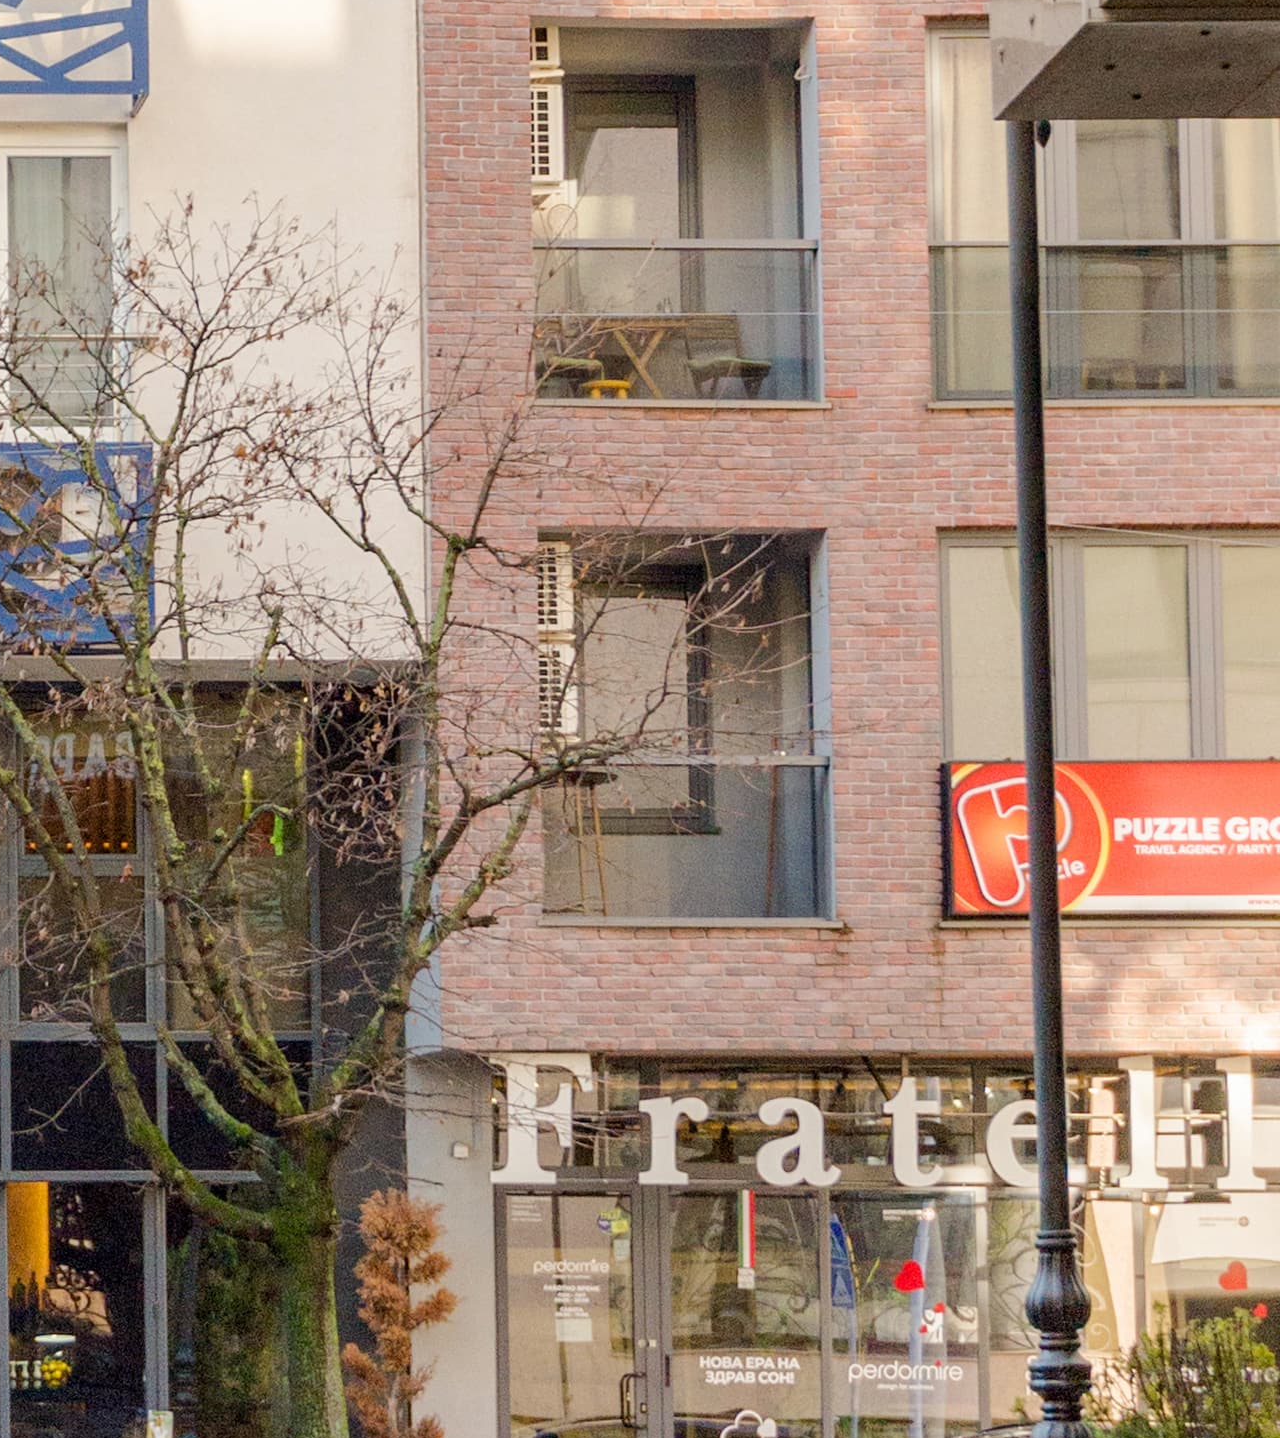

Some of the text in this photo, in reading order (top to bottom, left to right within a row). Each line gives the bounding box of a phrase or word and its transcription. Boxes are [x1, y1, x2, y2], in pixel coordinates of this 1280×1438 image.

[1113, 817, 1221, 842] PUZZLE
[1134, 844, 1176, 855] TRAVEL
[1178, 844, 1226, 855] AGENCY
[1237, 843, 1272, 855] PARTY
[533, 1259, 610, 1274] perdormire
[699, 1356, 801, 1370] НОВА ЕРА НА
[705, 1371, 795, 1385] ЗДРАВ СОН!
[848, 1360, 964, 1383] perdormire
